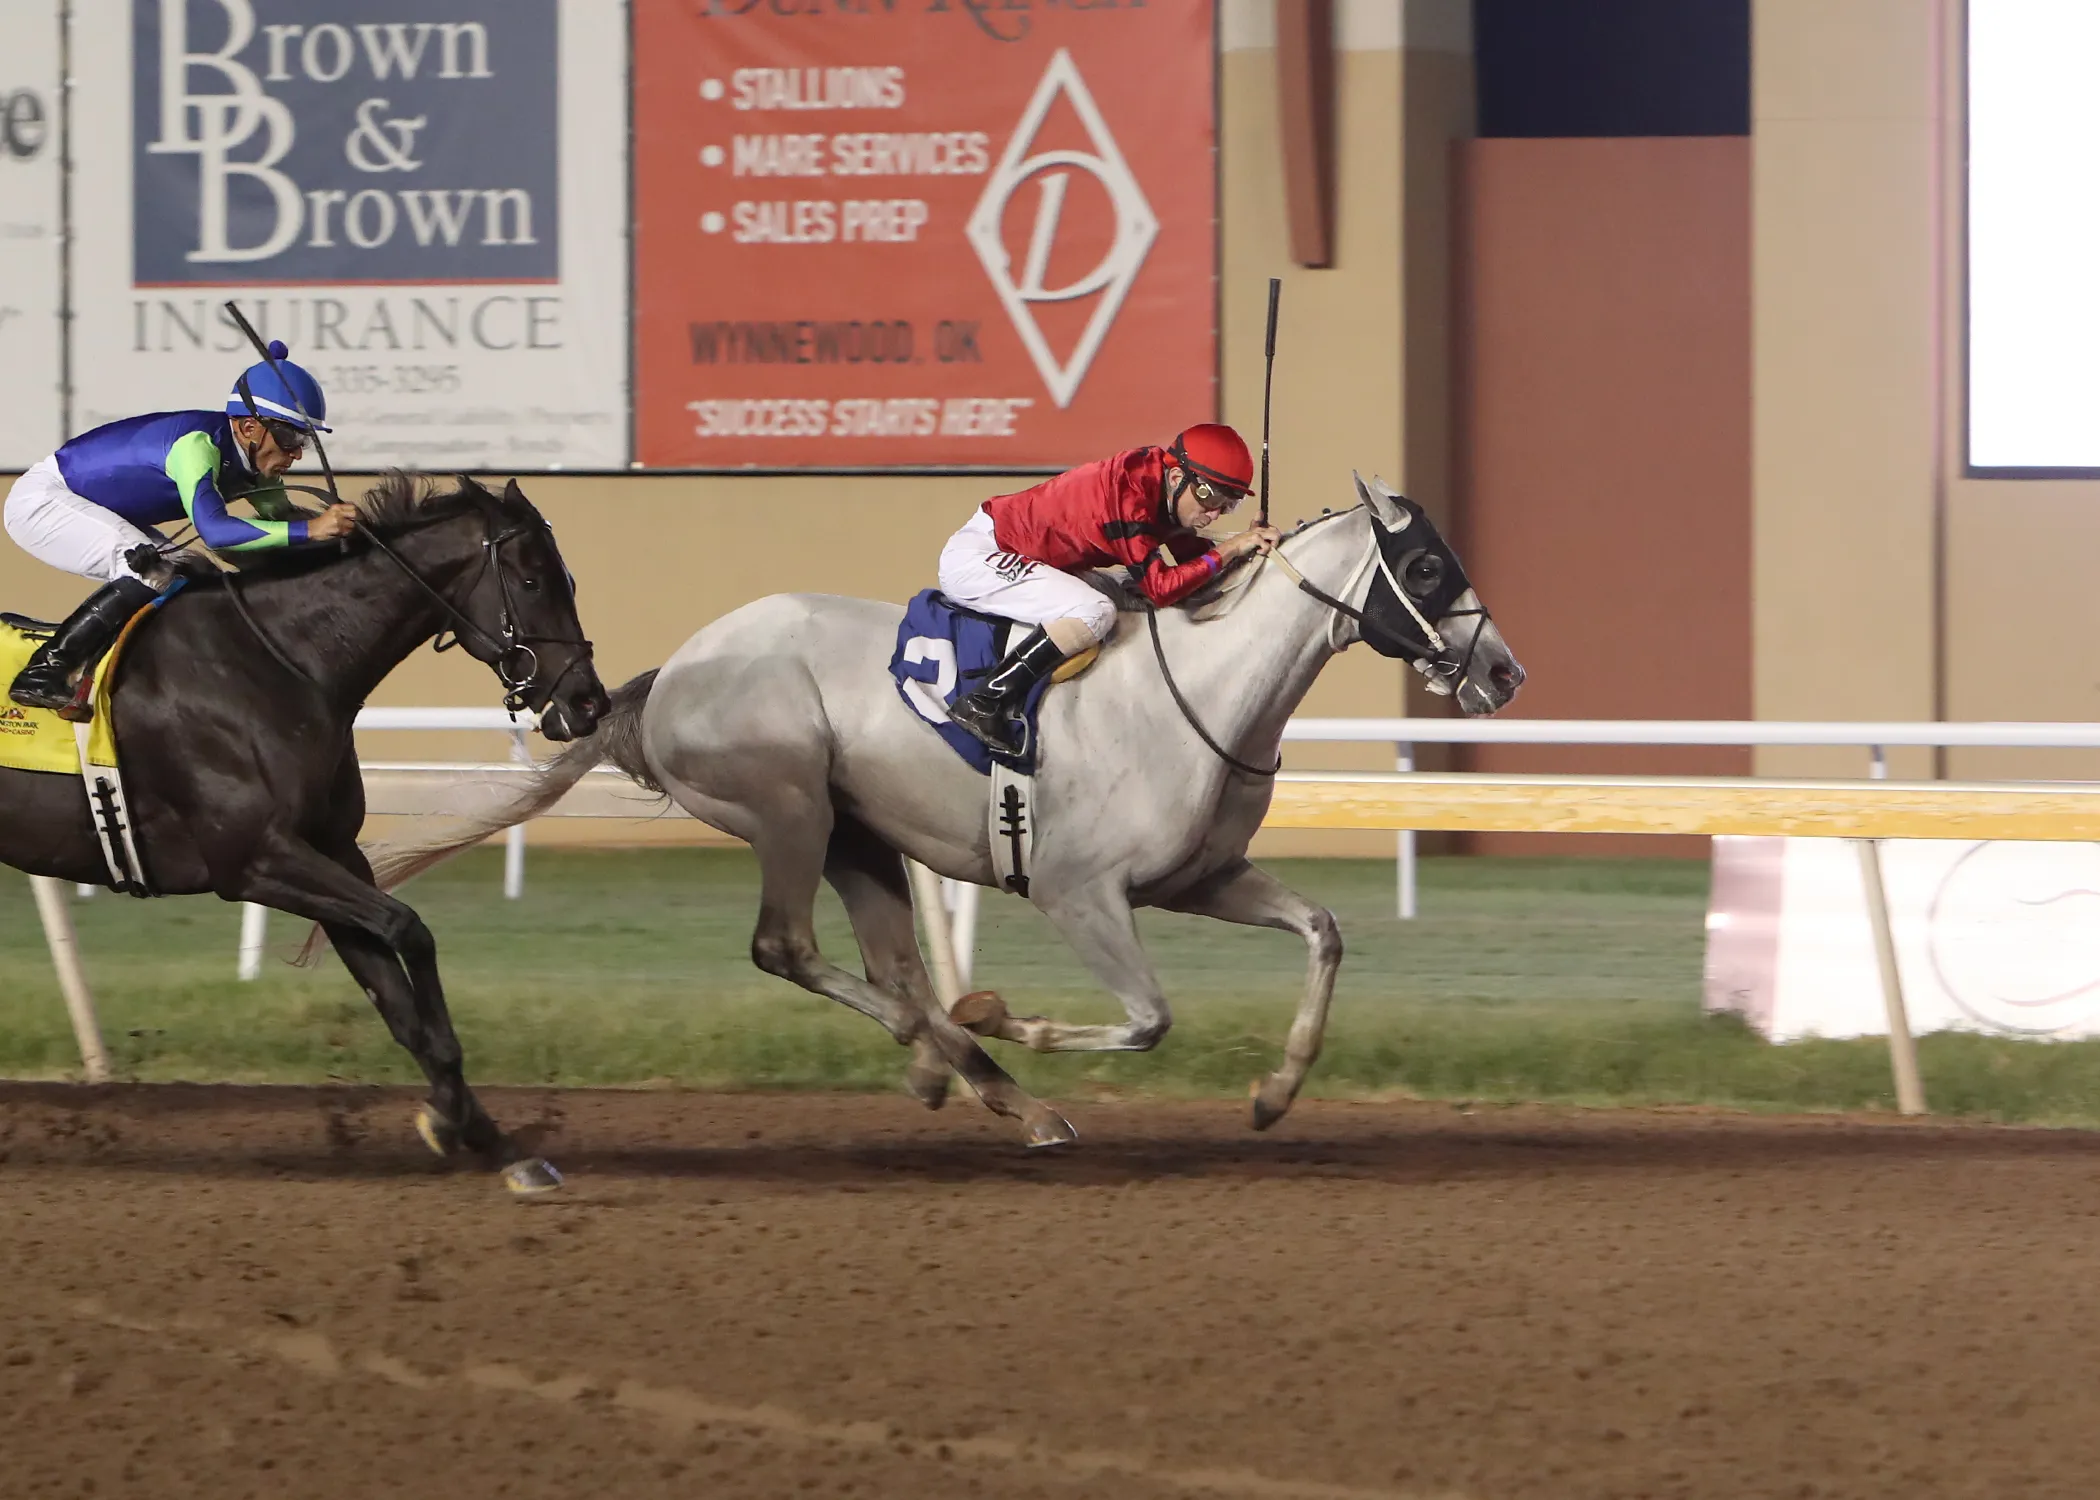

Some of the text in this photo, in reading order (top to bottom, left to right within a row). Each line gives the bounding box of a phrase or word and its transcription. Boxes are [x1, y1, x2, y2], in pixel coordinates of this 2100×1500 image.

[147, 0, 495, 152] Brown
[732, 66, 905, 110] STALLIONS
[346, 98, 428, 172] &
[733, 132, 990, 176] MARE SERVICES
[186, 95, 538, 262] Brown
[732, 199, 929, 243] SALES PREP
[131, 297, 563, 353] INSURANCE
[934, 320, 984, 363] OK
[830, 399, 941, 437] STARTS
[902, 635, 958, 724] 2
